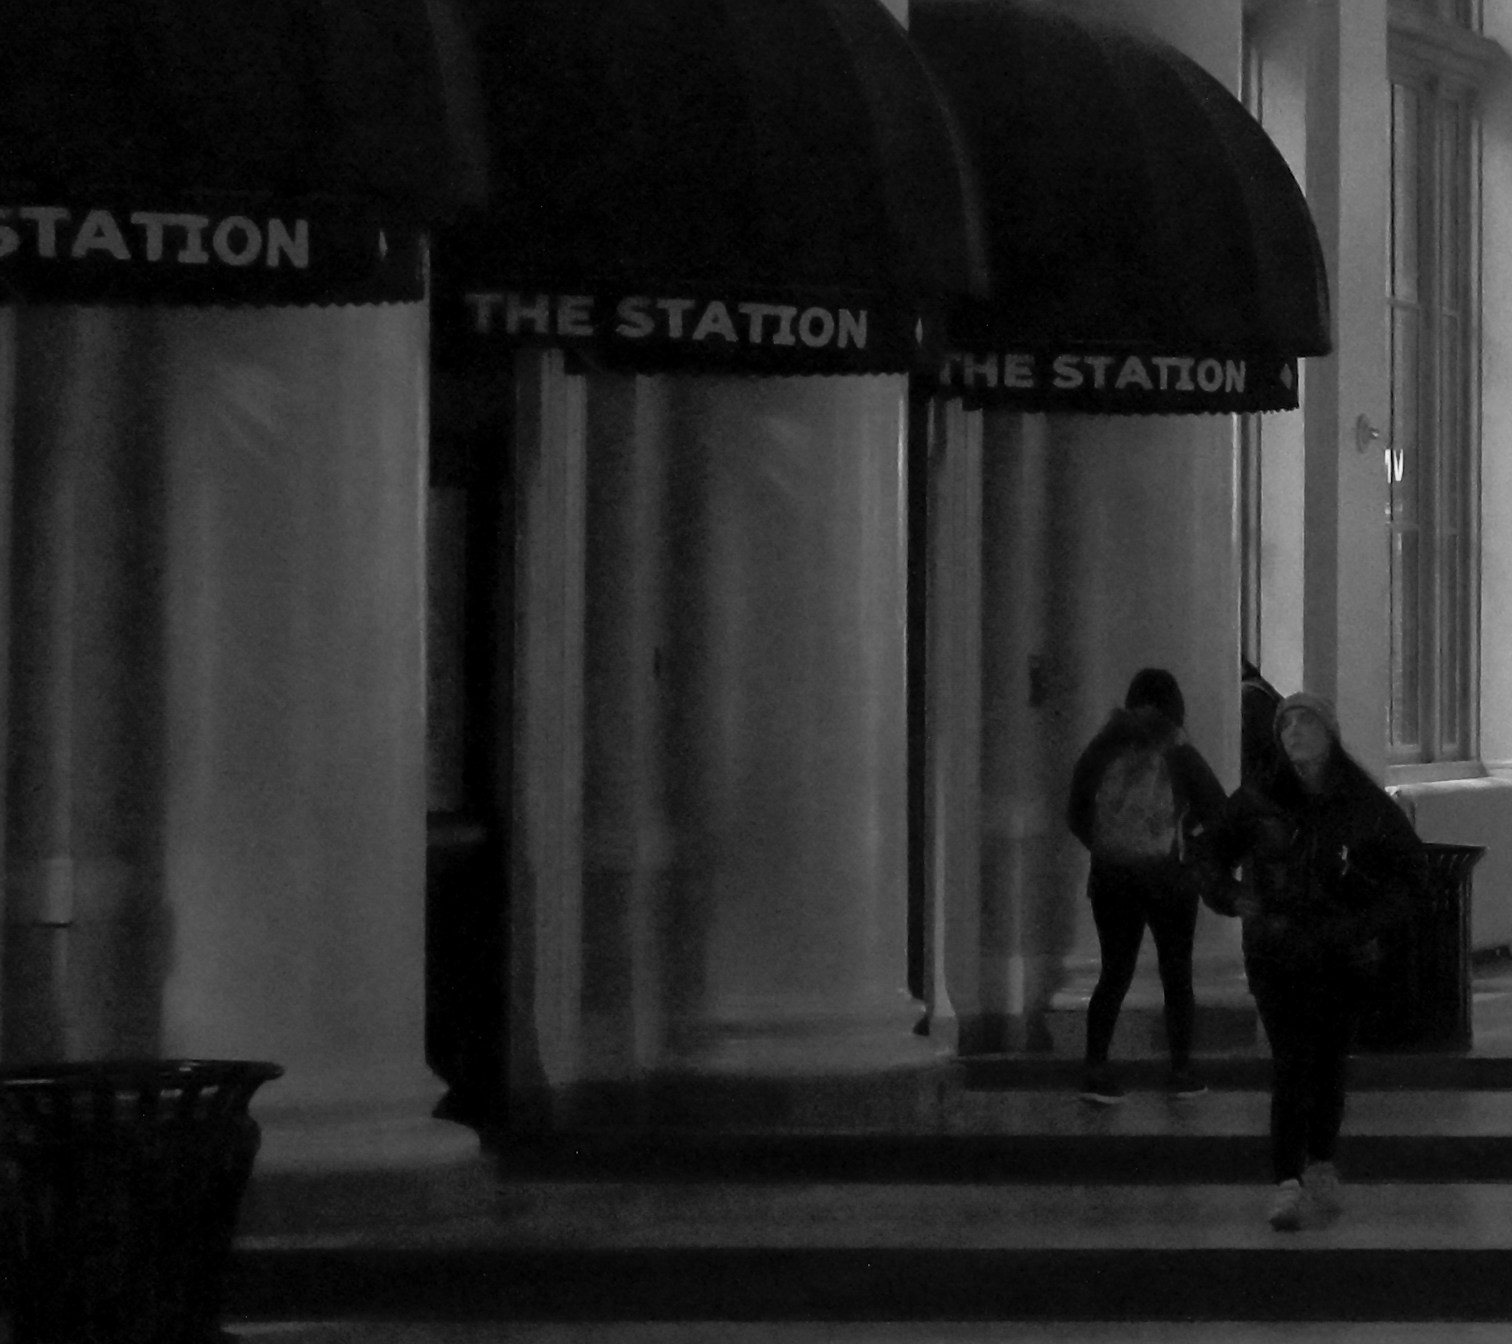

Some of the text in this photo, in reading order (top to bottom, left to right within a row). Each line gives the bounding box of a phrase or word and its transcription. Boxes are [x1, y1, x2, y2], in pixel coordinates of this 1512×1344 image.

[465, 291, 868, 350] THE STATION
[939, 353, 1246, 393] THE STATION
